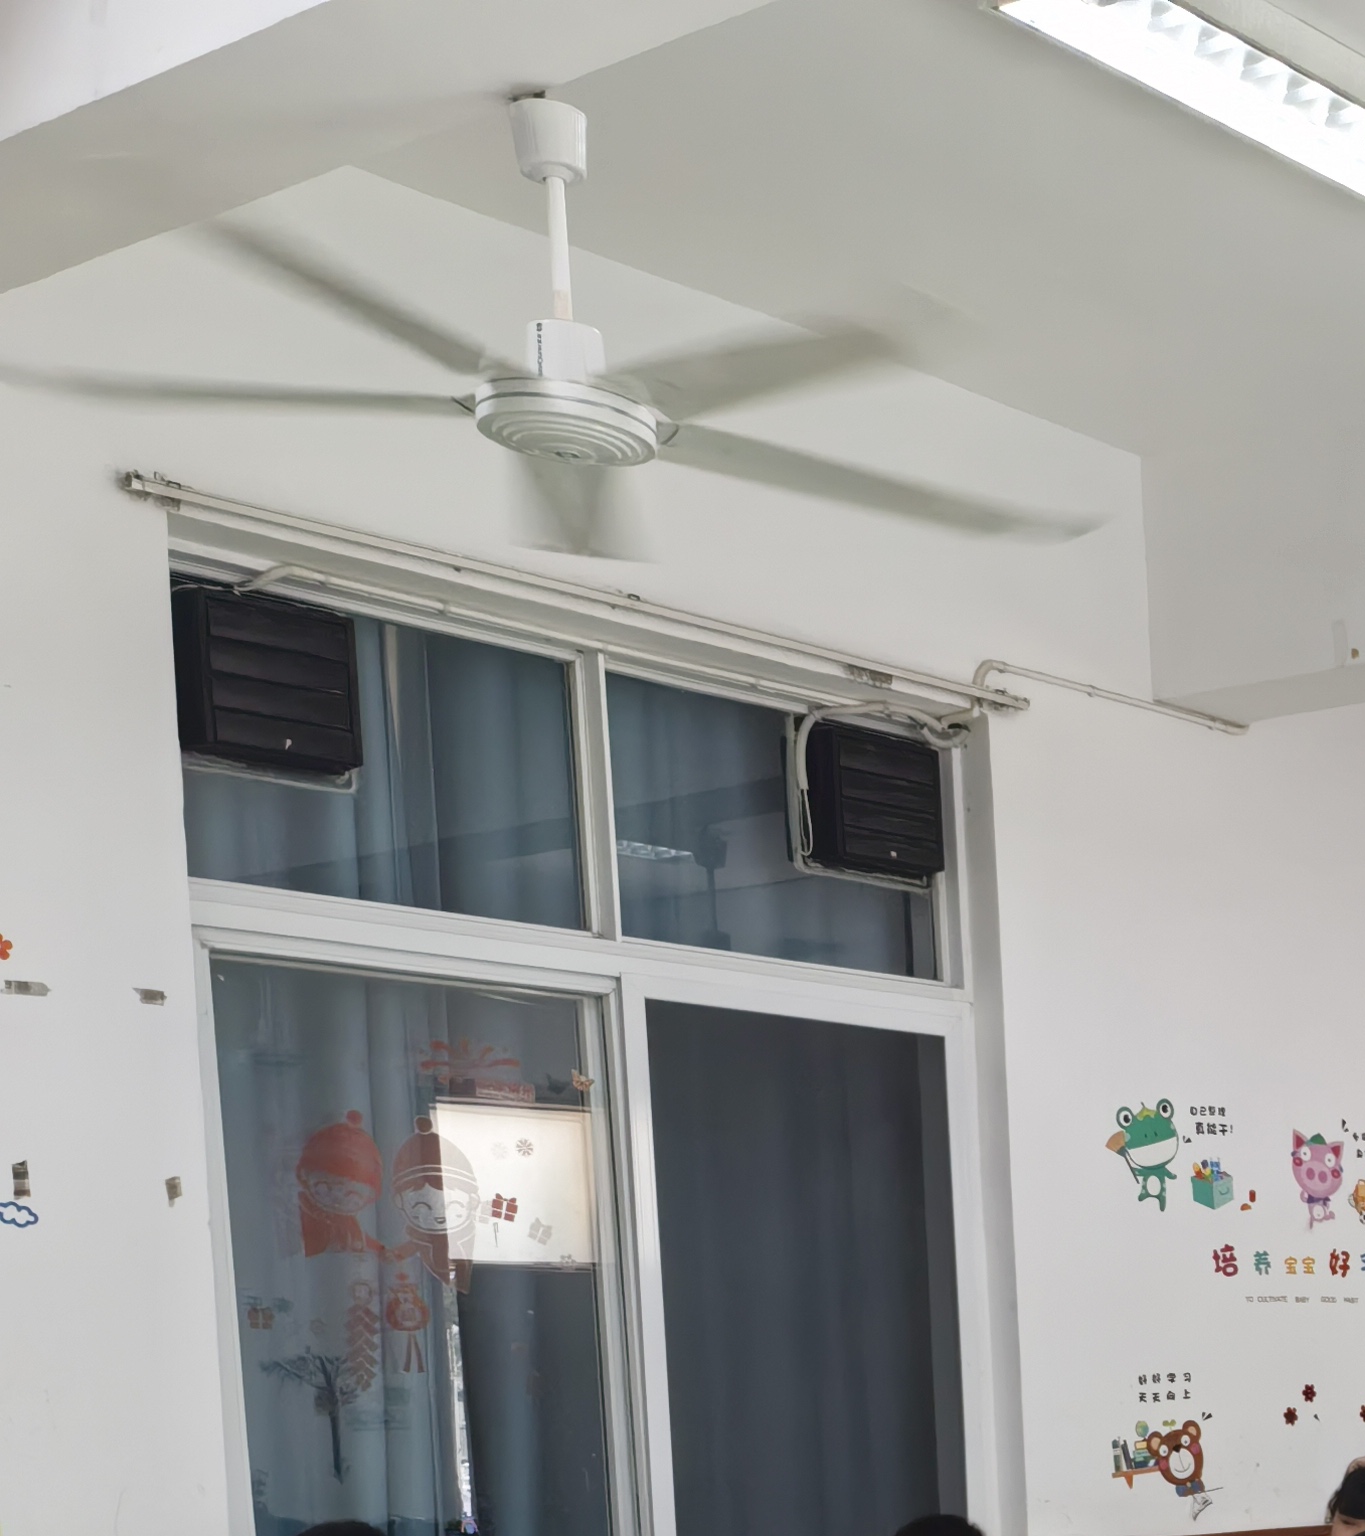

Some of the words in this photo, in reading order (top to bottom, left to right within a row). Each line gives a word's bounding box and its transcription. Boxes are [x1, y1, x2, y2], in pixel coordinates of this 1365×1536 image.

[1138, 1372, 1192, 1385] 好好学习
[1138, 1389, 1191, 1403] 天天向上
